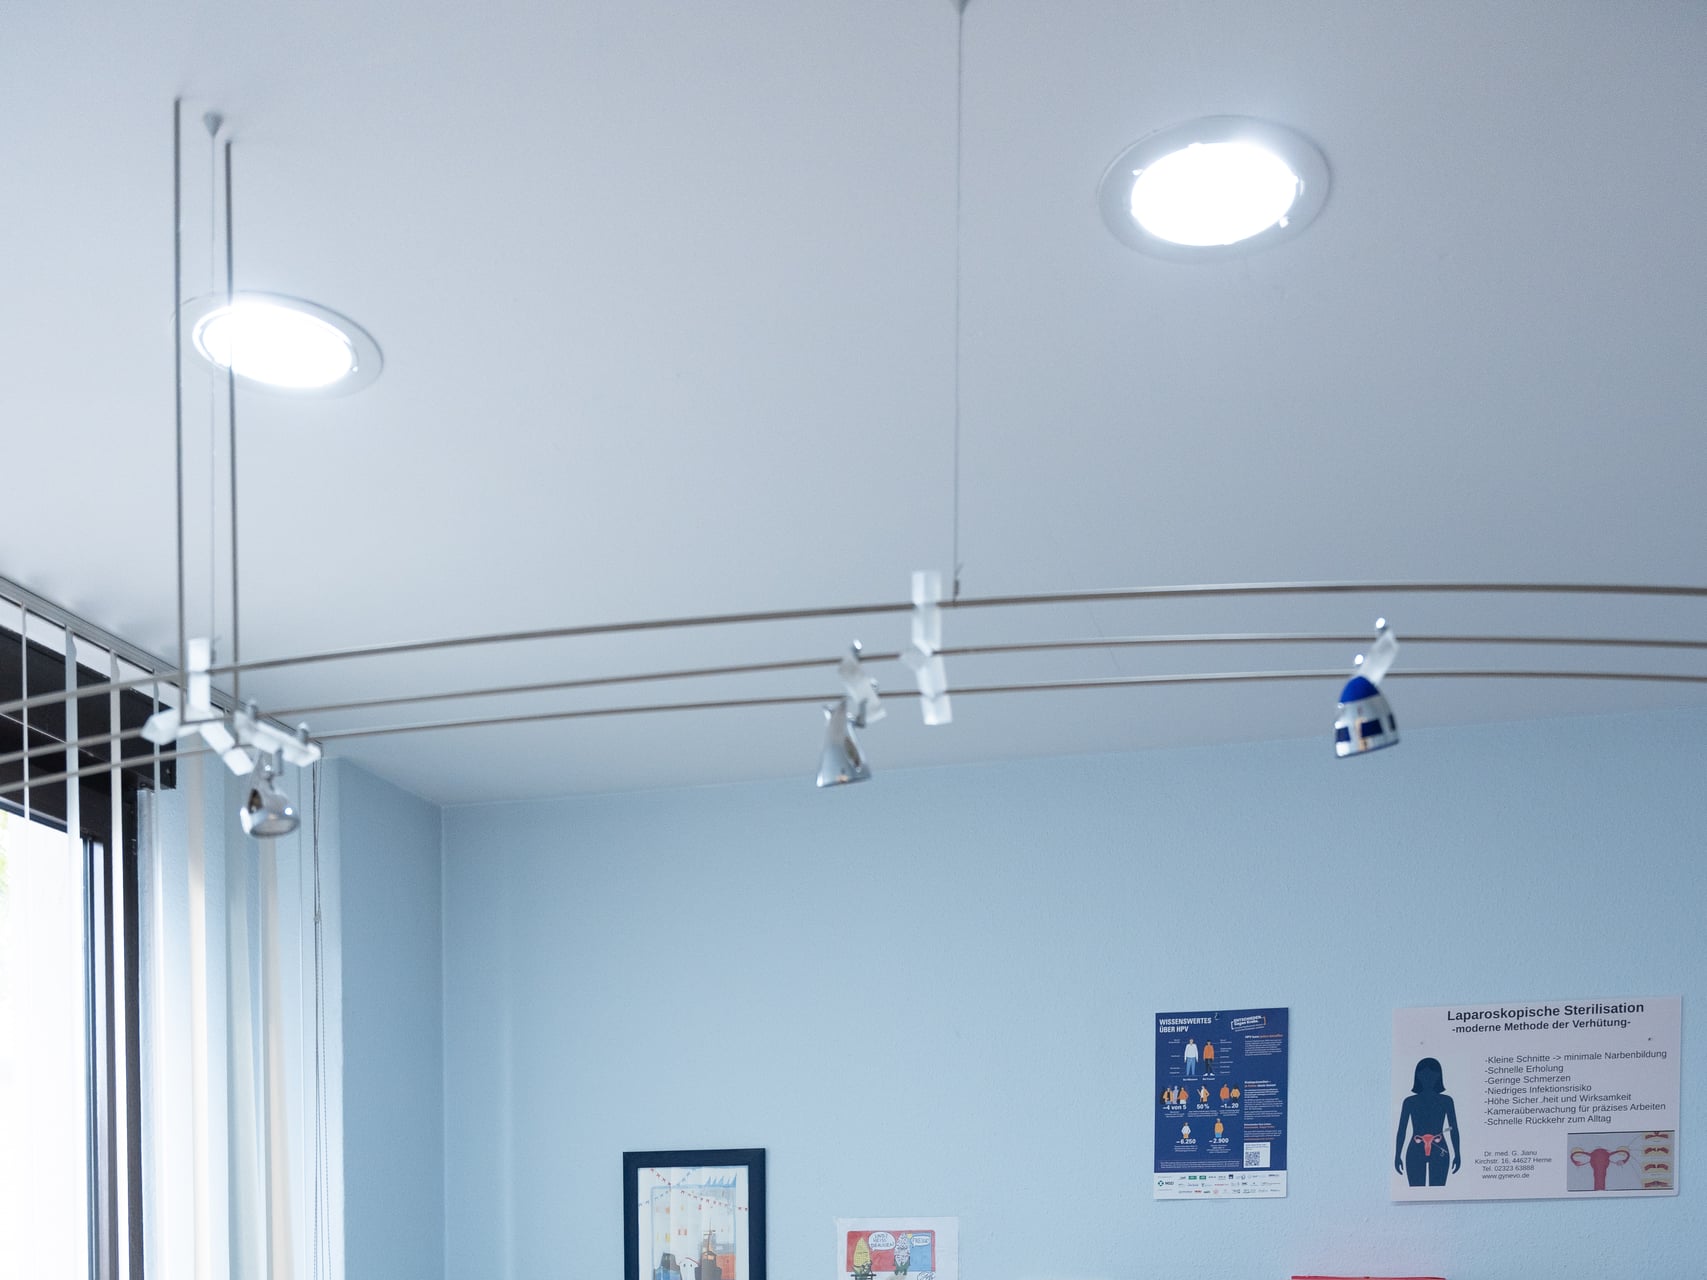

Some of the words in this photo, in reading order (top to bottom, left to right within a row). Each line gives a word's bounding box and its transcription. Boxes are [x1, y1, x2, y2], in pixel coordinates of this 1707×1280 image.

[1447, 1005, 1560, 1023] Laparoskopische
[1564, 1002, 1644, 1016] Sterilisation
[1159, 1017, 1212, 1026] WISSENSWERTES
[1452, 1023, 1501, 1033] -moderne
[1504, 1020, 1549, 1031] Methode
[1552, 1019, 1569, 1029] der
[1572, 1017, 1631, 1029] Verhütung-
[1159, 1025, 1176, 1033] ÜBER
[1516, 1055, 1550, 1063] Schnitte
[1564, 1053, 1602, 1061] minimale
[1604, 1050, 1667, 1061] Narbenbildung
[1526, 1065, 1564, 1074] Erholung
[1523, 1075, 1571, 1084] Schmerzen
[1529, 1084, 1592, 1094] Infektionsrisiko
[1560, 1095, 1577, 1103] und
[1579, 1093, 1632, 1102] Wirksamkeit
[1579, 1104, 1590, 1113] für
[1592, 1104, 1628, 1114] präzises
[1630, 1102, 1666, 1111] Arbeiten
[1525, 1116, 1565, 1125] Rückkehr
[1567, 1116, 1586, 1124] zum
[1588, 1115, 1612, 1124] Alltag
